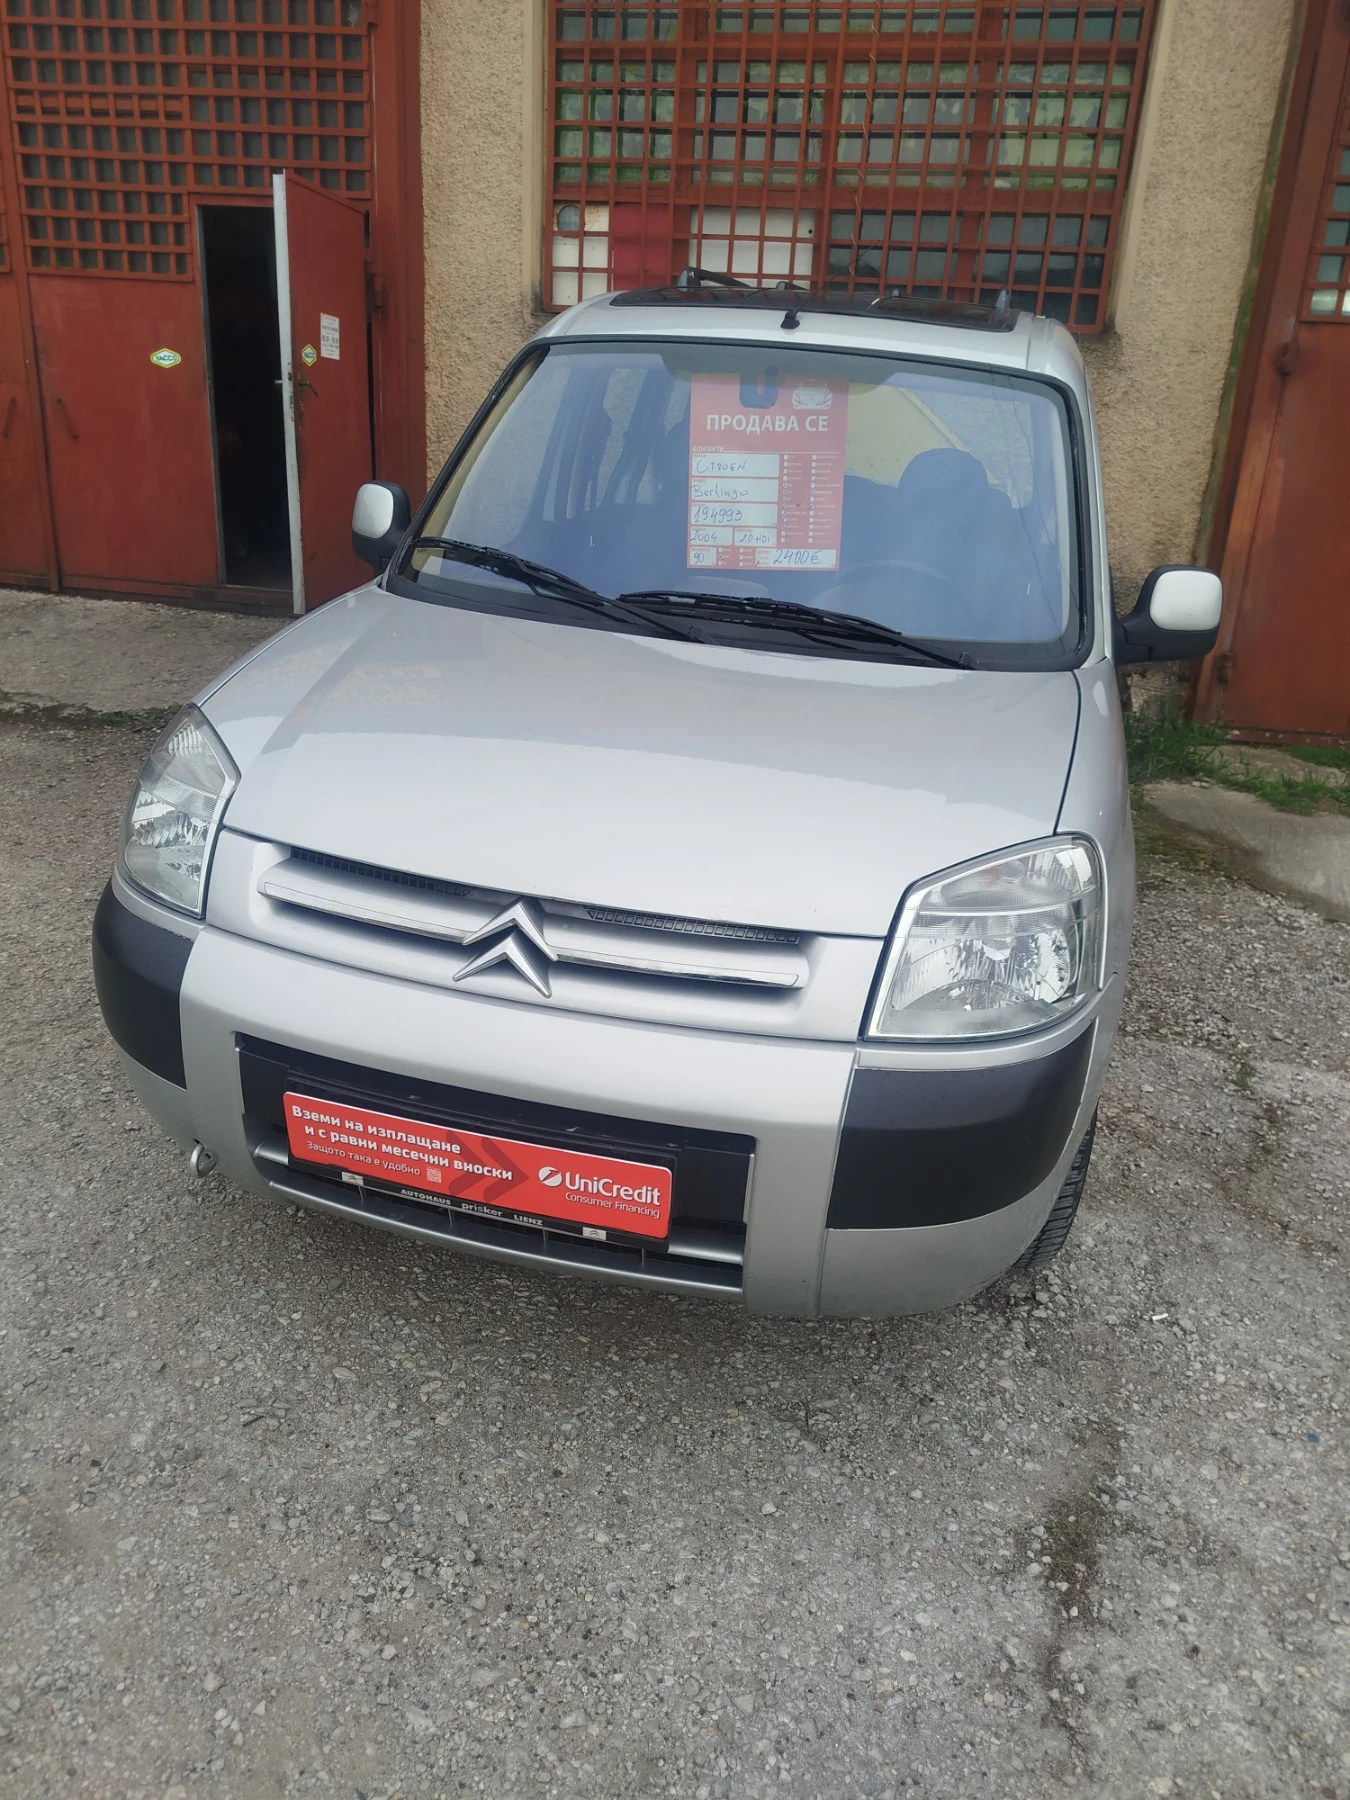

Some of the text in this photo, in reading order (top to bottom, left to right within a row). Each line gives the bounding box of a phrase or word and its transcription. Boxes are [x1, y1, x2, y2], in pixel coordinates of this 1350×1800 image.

[155, 354, 177, 362] YACCO
[706, 414, 828, 435] ПРОДАВА СЕ
[692, 445, 725, 453] КОНТАКТИ
[693, 506, 743, 524] 194993
[690, 530, 717, 544] 2004
[693, 552, 705, 565] 90
[292, 1105, 461, 1154] Вземи на изплащане
[304, 1126, 513, 1181] и с равни месечни вноски
[307, 1141, 421, 1176] Защото така е удобно
[565, 1171, 661, 1206] UniCredit
[400, 1188, 544, 1226] AUTOHAUS prisker LIENZ
[565, 1192, 660, 1220] Consumer Financing
